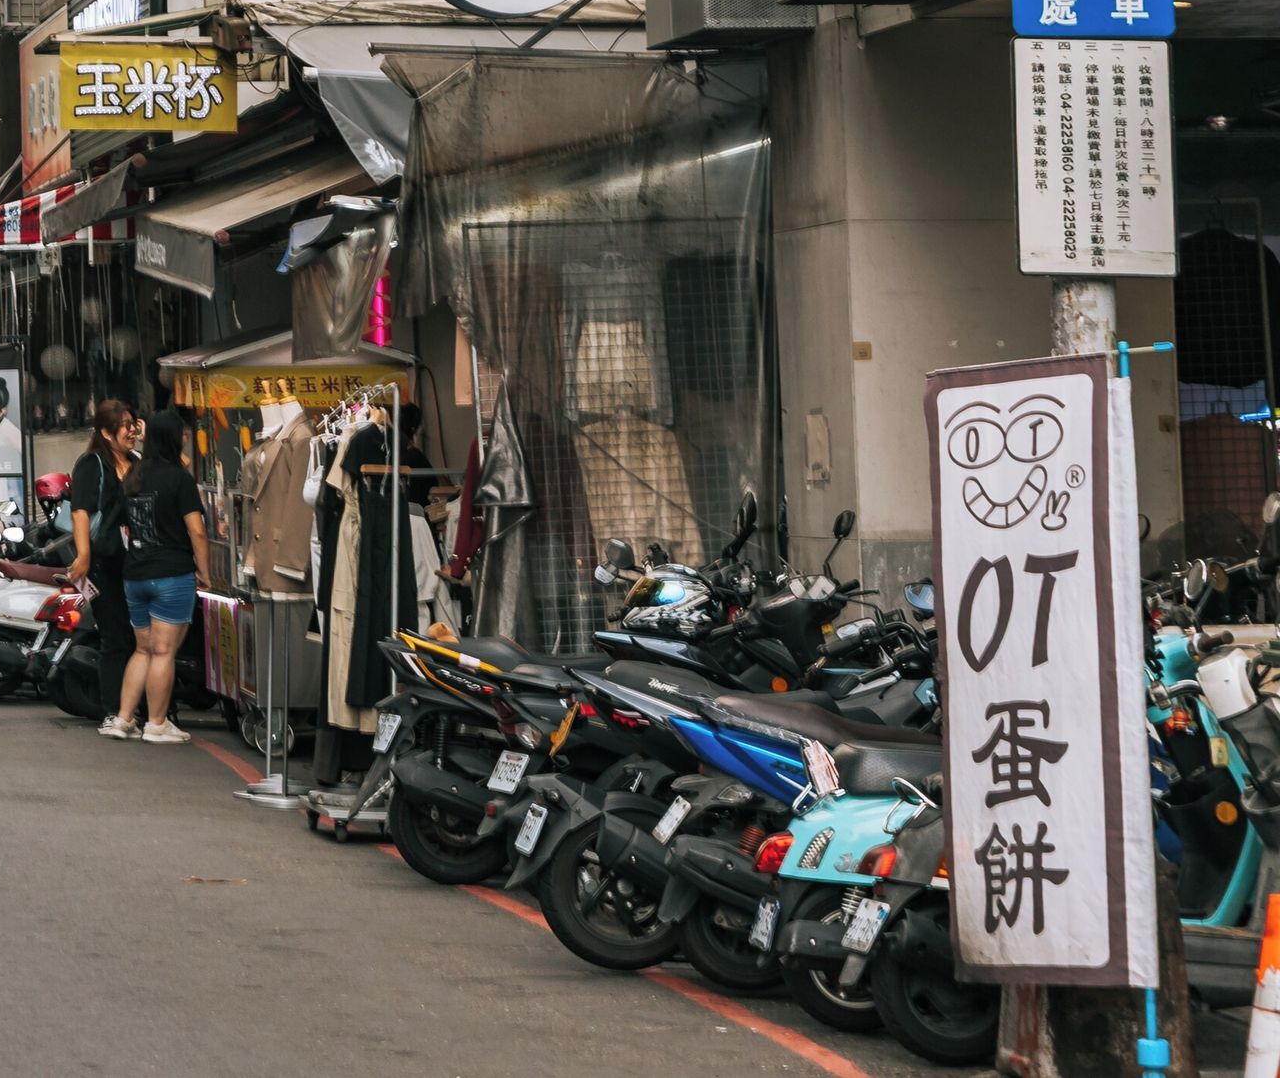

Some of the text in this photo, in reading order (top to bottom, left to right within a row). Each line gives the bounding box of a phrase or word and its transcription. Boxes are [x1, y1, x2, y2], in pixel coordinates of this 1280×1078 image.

[73, 61, 222, 121] 玉米杯
[957, 549, 1079, 673] OT
[971, 699, 1070, 936] 蛋餅
